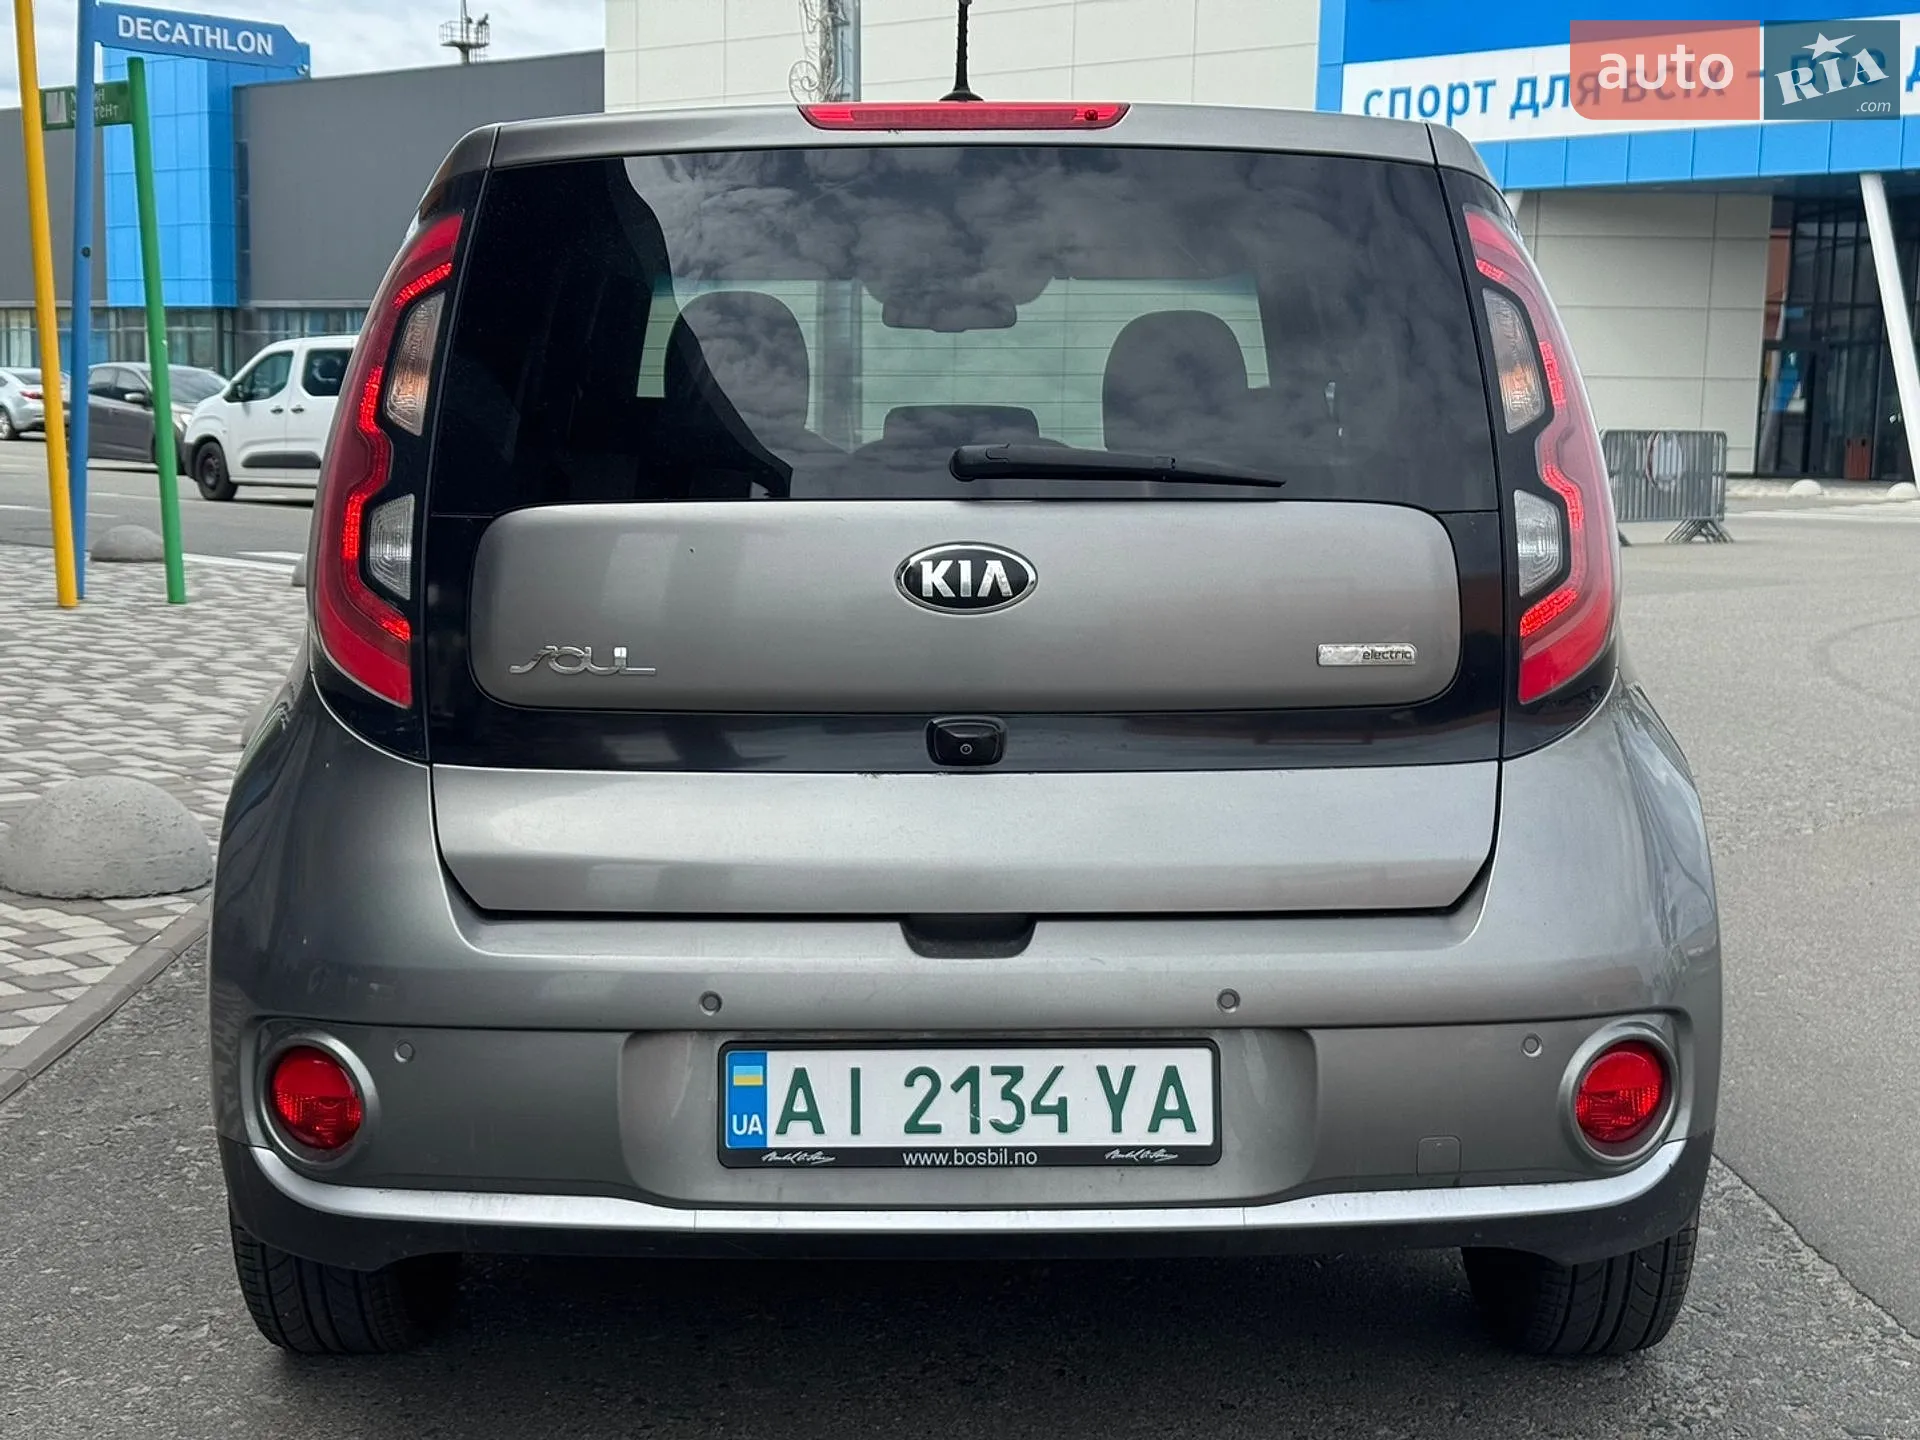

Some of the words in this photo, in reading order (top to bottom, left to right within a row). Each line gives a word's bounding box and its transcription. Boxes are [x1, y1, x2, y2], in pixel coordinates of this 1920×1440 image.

[117, 14, 274, 56] DECATHLON
[919, 559, 1014, 598] KIA
[509, 645, 657, 676] SOUL
[1362, 649, 1413, 661] electric
[775, 1066, 862, 1136] AI
[903, 1065, 1069, 1134] 2134
[1095, 1065, 1197, 1133] YA
[732, 1116, 764, 1136] UA
[902, 1148, 1038, 1166] www.bosbil.no
